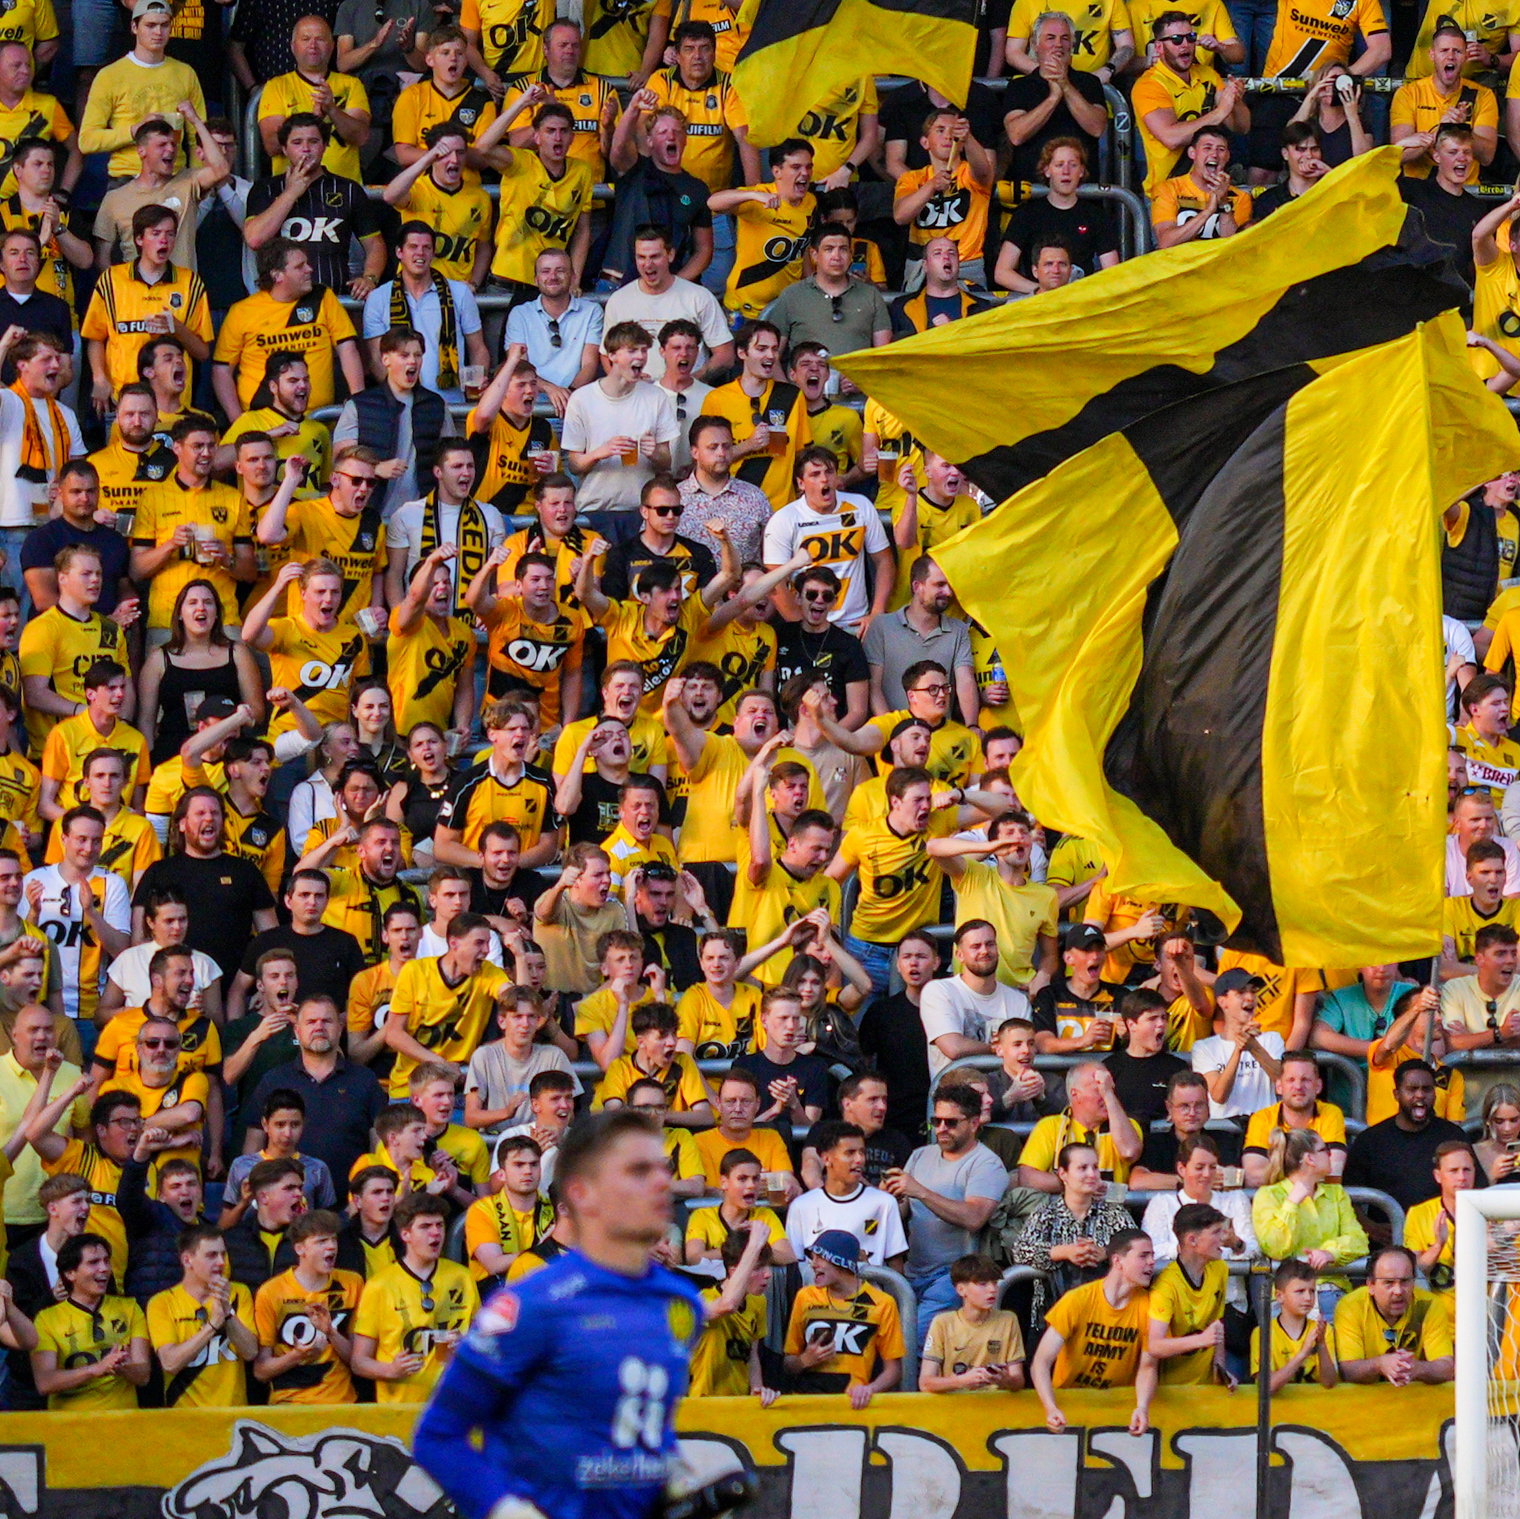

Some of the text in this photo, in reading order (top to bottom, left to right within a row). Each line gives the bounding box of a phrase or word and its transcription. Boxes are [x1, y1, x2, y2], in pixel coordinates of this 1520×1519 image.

[491, 19, 542, 49] OK
[1290, 10, 1349, 35] Sunweb
[799, 114, 851, 141] OK
[281, 218, 342, 241] OK
[526, 207, 568, 237] OK
[763, 237, 807, 260] OK
[256, 328, 322, 346] Sunweb
[799, 534, 859, 558] OK
[505, 638, 566, 672] OK
[300, 658, 356, 689] OK
[805, 1320, 868, 1351] OK
[1085, 1321, 1139, 1342] YELLOW
[1085, 1342, 1129, 1358] ARMY
[1091, 1362, 1104, 1375] IS
